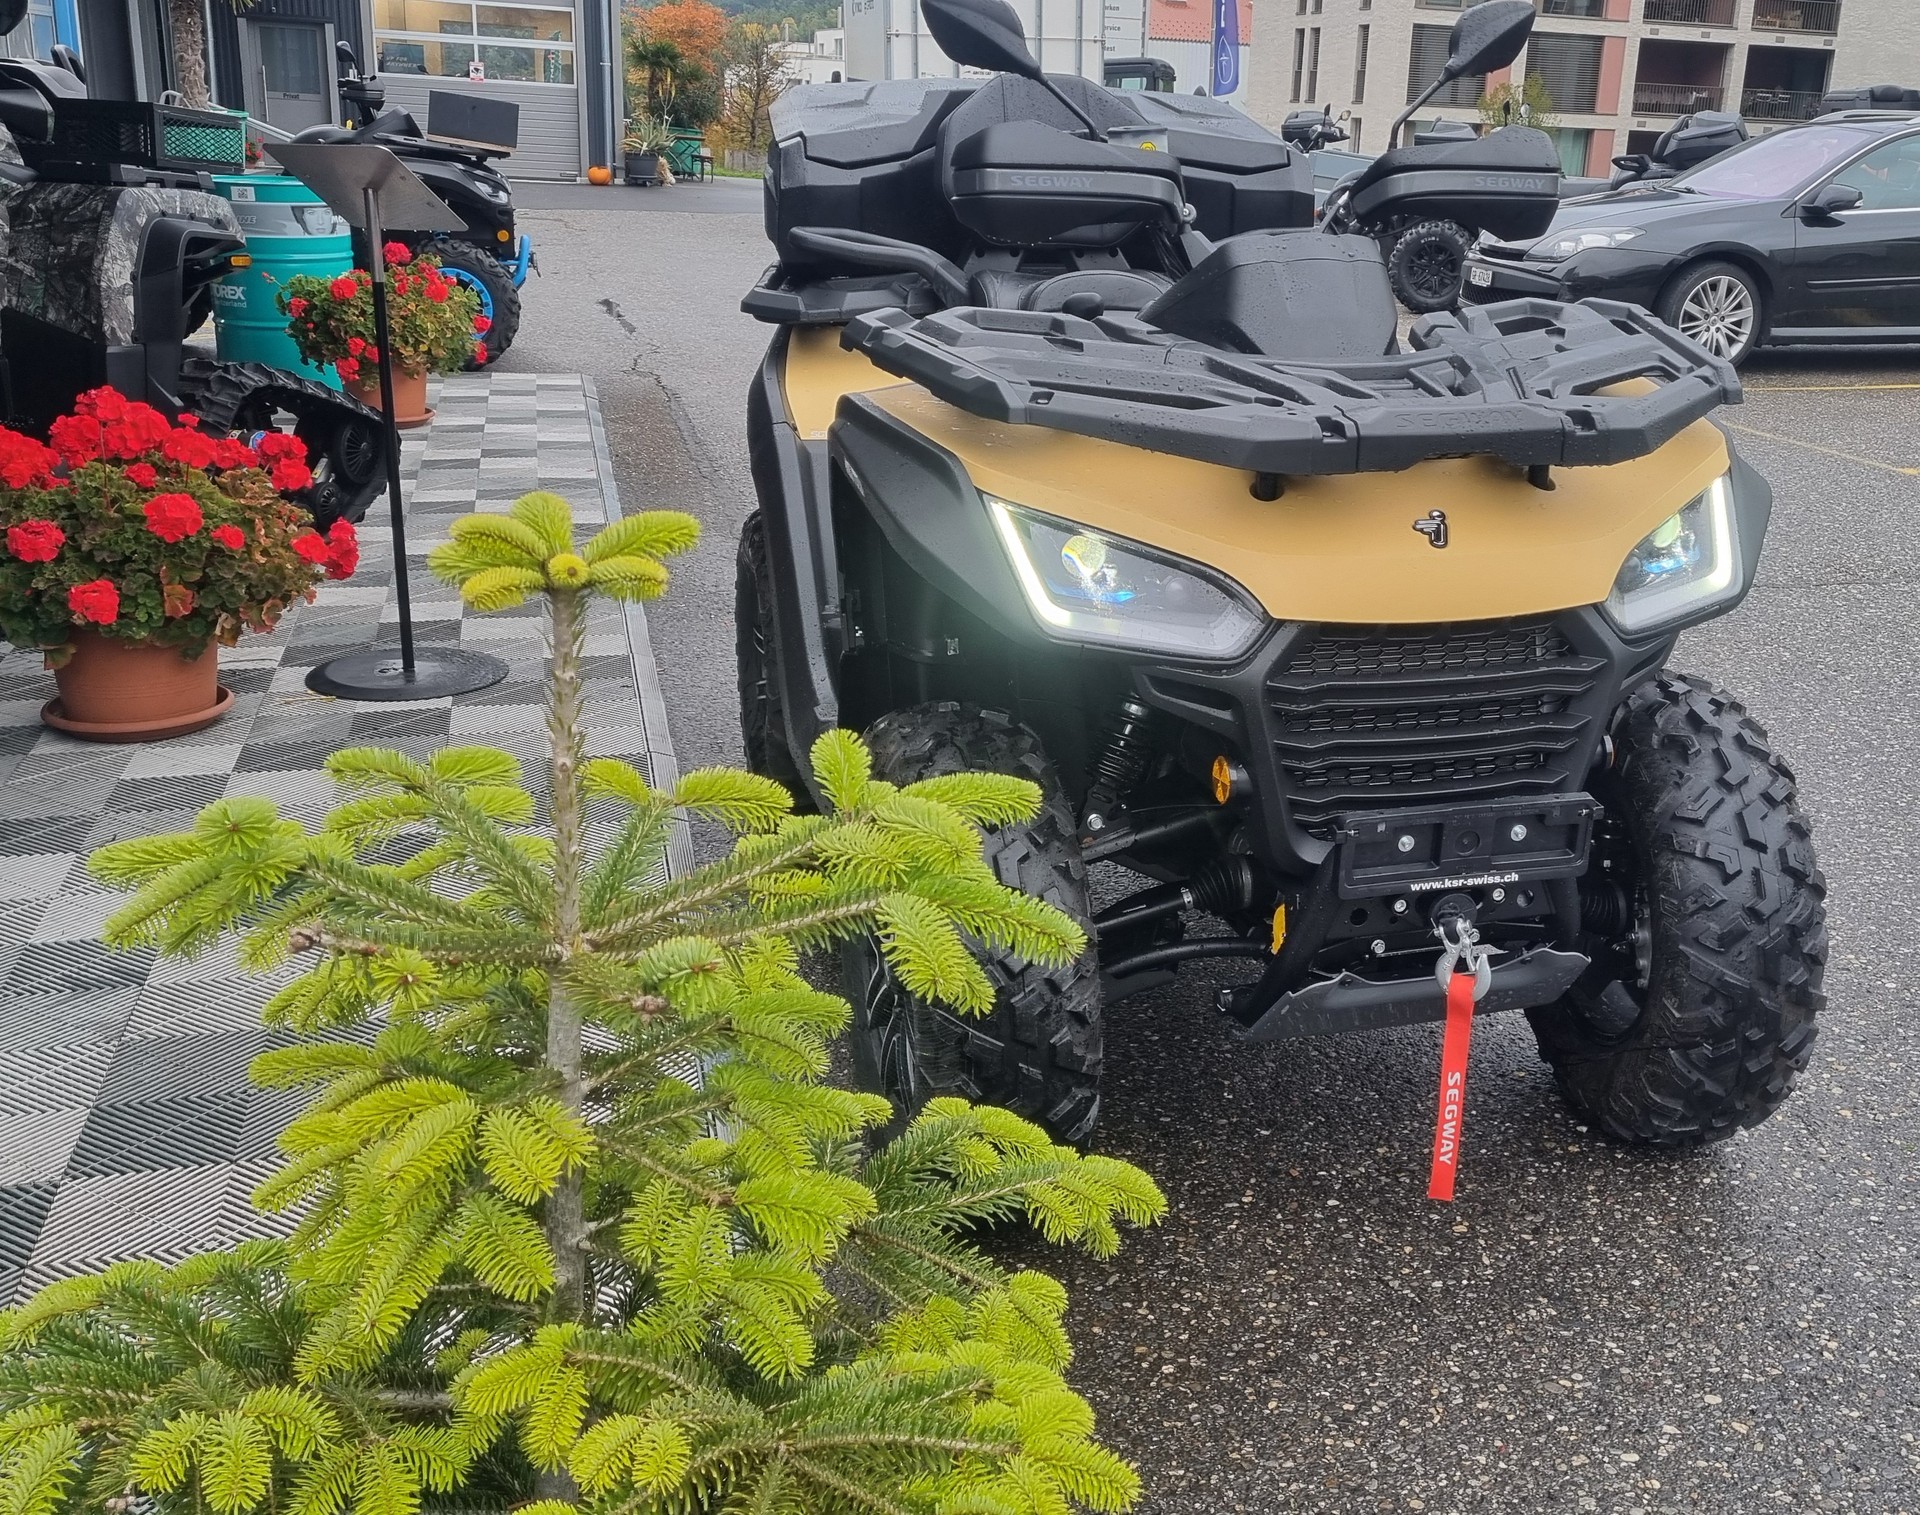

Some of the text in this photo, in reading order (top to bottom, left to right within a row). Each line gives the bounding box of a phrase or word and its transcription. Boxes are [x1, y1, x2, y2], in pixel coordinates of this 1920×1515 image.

[282, 92, 300, 100] Privat
[1010, 175, 1094, 188] SEGWAY
[1474, 176, 1545, 190] SEGWAY
[1410, 872, 1519, 892] www.ksr-swiss.ch
[1439, 1071, 1461, 1165] SEGWAY
